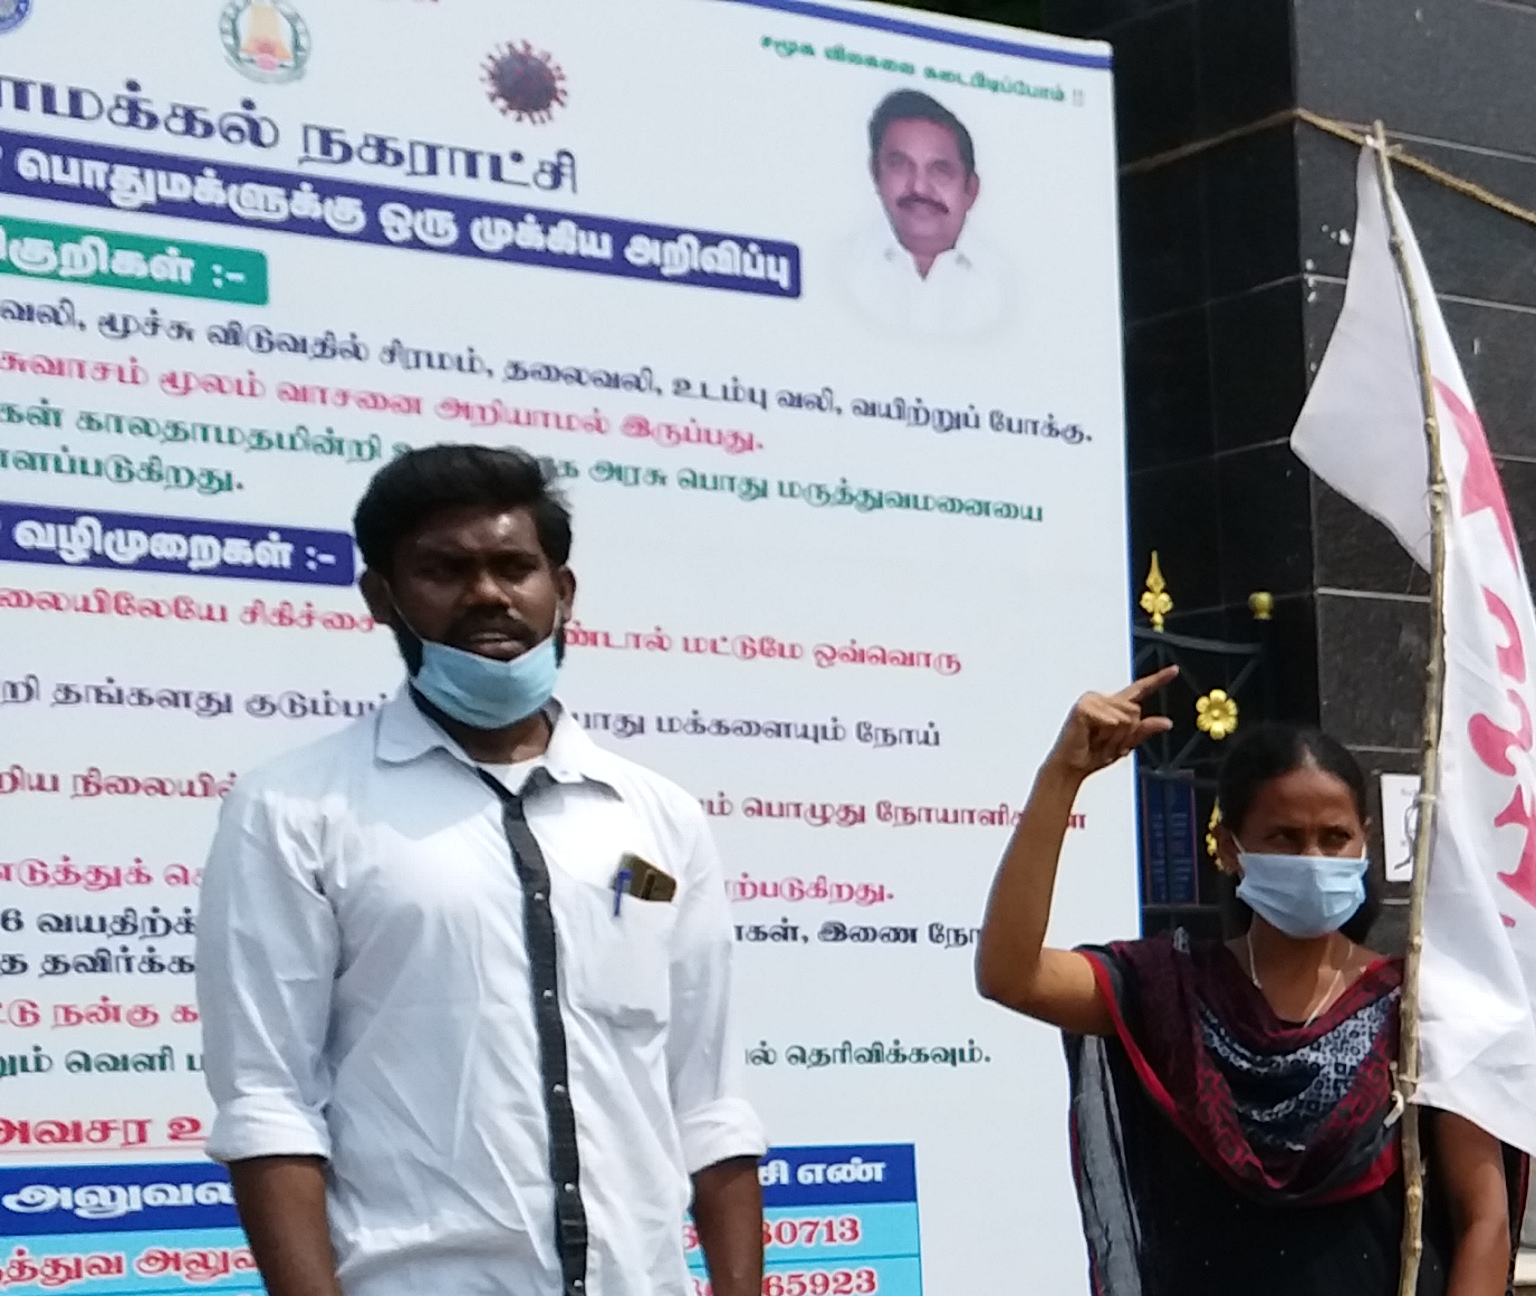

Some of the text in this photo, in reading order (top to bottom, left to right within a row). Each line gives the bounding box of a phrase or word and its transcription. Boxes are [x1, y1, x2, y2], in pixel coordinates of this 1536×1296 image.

[0, 75, 580, 194] ாமக்கல் நகராட்சி
[17, 147, 792, 289] பொதுமக்களுக்கு ஒரு முக்கிய அறிவிப்பு
[98, 307, 195, 342] மூச்சு
[206, 320, 369, 363] விடுவதில்
[379, 337, 495, 380] சிரமம்,
[502, 358, 663, 396] தலைவலி,
[672, 375, 767, 410] உடம்பு
[776, 386, 843, 416] வலி,
[852, 396, 980, 432] வயிற்றுப்
[990, 410, 1093, 444] போக்கு.
[160, 367, 266, 401] மூலம்
[276, 380, 422, 418] வாசனை
[435, 396, 609, 436] அறியாமல்
[622, 411, 763, 454] இருப்பது.
[76, 408, 382, 464] காலதாமதமின்றி
[589, 458, 667, 488] அரசு
[677, 467, 768, 502] பொது
[778, 476, 1043, 523] மருத்துவமனையை
[14, 515, 294, 571] வழிமுறைகள்
[683, 632, 962, 675] மட்டுமே ஒவ்வொரு
[51, 676, 233, 718] தங்களது
[657, 709, 940, 749] மக்களையும் நோய்
[742, 796, 866, 828] பொழுது
[818, 920, 918, 945] இணை
[52, 994, 160, 1030] நன்கு
[65, 1044, 175, 1074] வெளி
[785, 1037, 991, 1071] தெரிவிக்கவும்.
[797, 1156, 886, 1186] எண்
